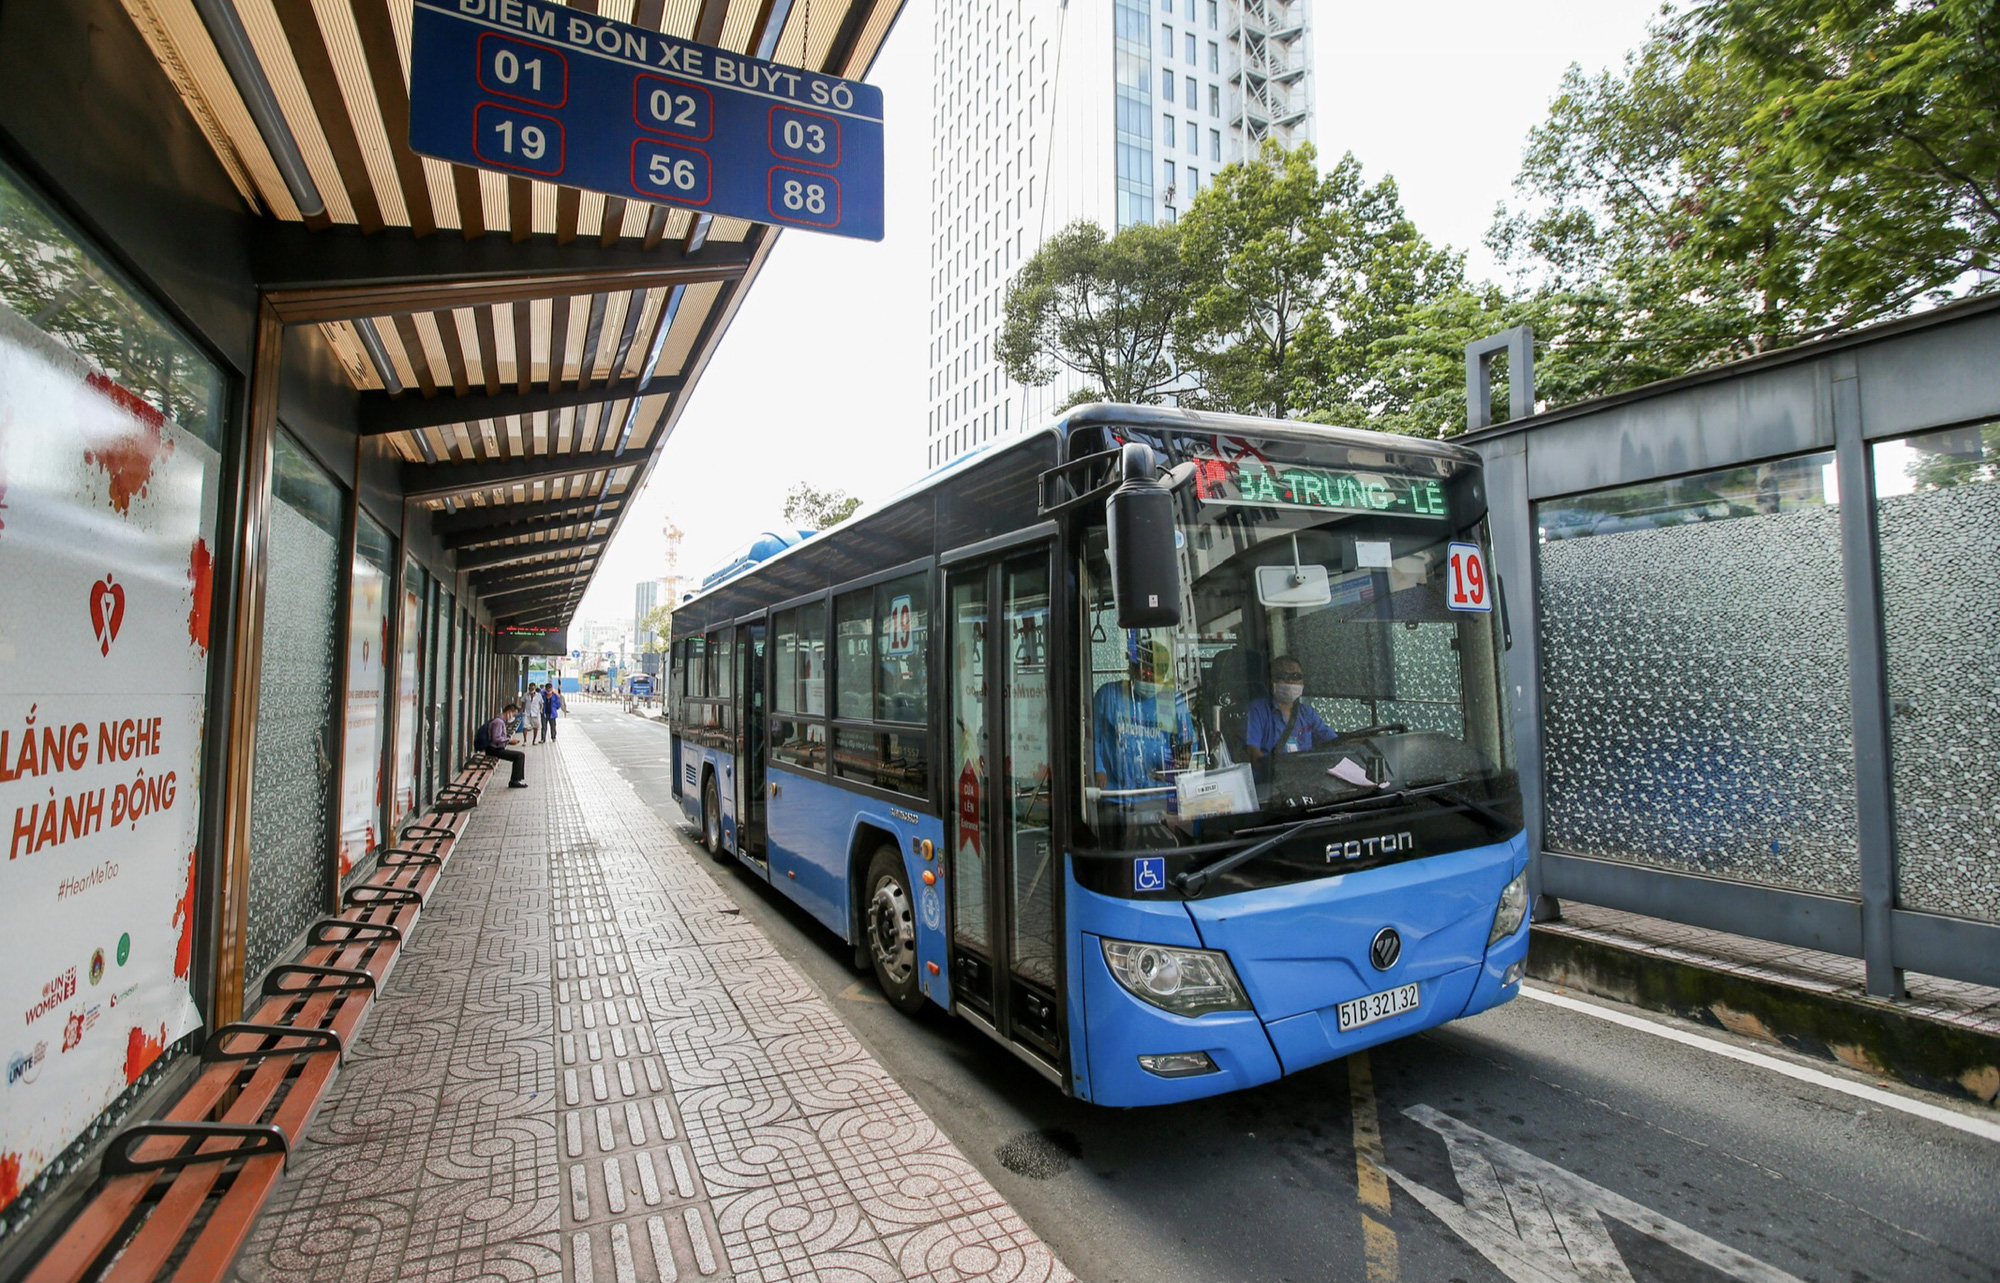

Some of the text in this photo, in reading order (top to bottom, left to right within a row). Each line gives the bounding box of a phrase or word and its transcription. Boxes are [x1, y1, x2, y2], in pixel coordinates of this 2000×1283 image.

[494, 49, 542, 91] 01
[568, 17, 648, 62] ĐÓN
[658, 40, 703, 76] XE
[715, 57, 801, 97] BUÝT
[810, 80, 854, 110] SỐ
[650, 89, 697, 128] 02
[495, 121, 546, 159] 19
[784, 120, 826, 153] 03
[649, 156, 695, 190] 56
[784, 180, 825, 214] 88
[1283, 473, 1389, 510] TRƯNG
[1411, 481, 1445, 515] LÊ
[1450, 553, 1484, 604] 19
[891, 604, 910, 649] 19
[0, 703, 162, 783] LẮNG NGHE
[9, 767, 176, 860] HÀNH ĐỘNG
[961, 818, 979, 832] Entrance
[1325, 831, 1413, 863] FOTON
[57, 860, 119, 902] #HearMeToo
[51, 974, 64, 993] UN
[25, 990, 63, 1027] WOMEN
[1340, 985, 1417, 1028] 51B-321.32
